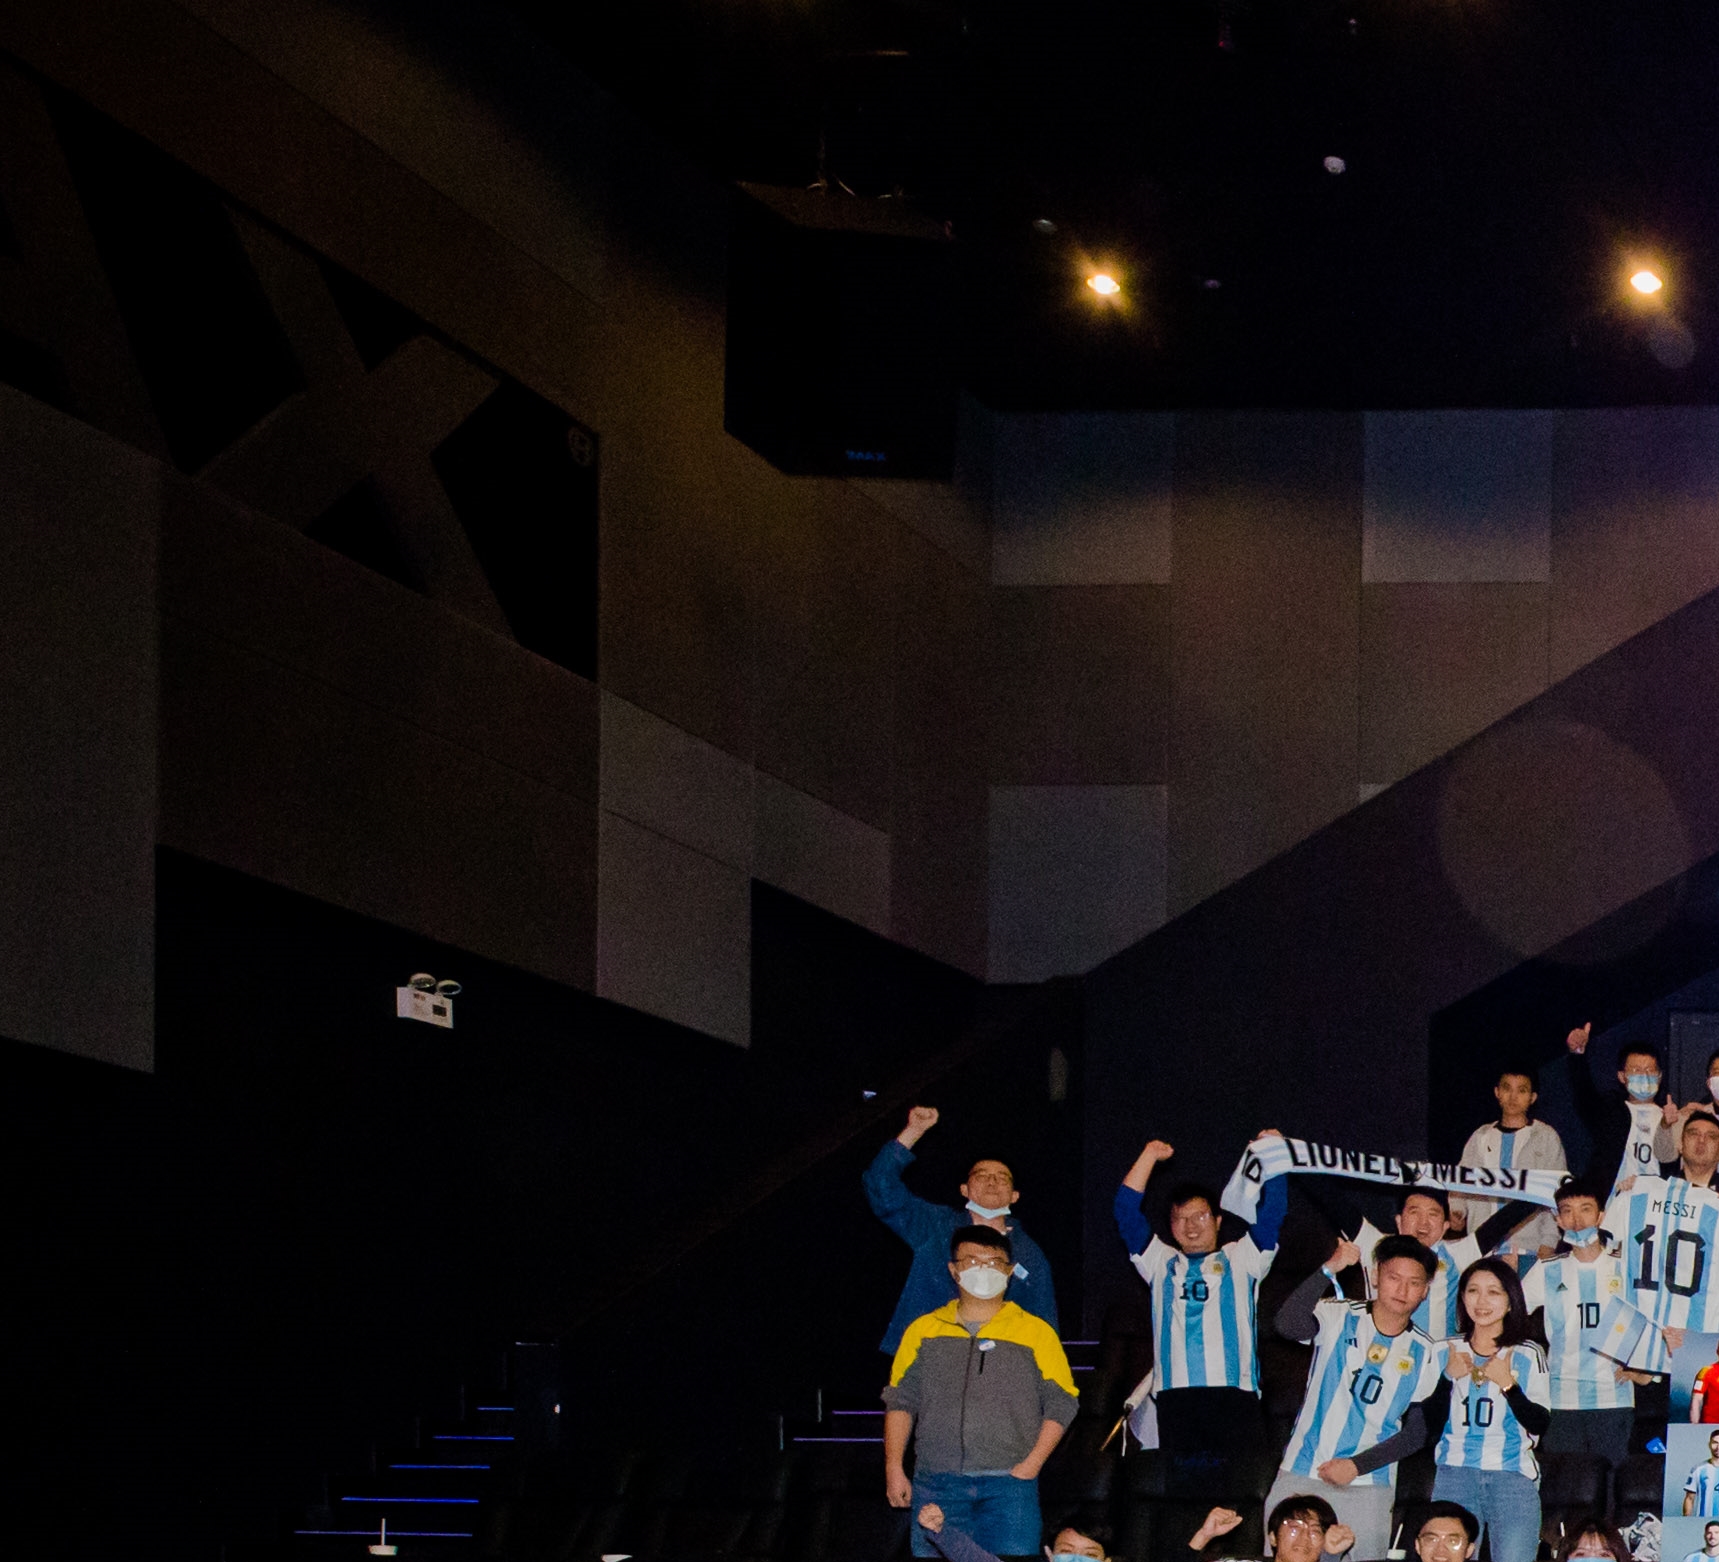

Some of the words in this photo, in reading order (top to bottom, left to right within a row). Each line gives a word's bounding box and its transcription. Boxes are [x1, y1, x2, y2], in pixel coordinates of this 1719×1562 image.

[1632, 1140, 1652, 1160] 10
[1430, 1162, 1528, 1191] MESSI
[1652, 1199, 1696, 1219] MESSI
[1632, 1225, 1705, 1298] 10
[1576, 1302, 1600, 1330] 10
[1349, 1369, 1384, 1405] 10
[1460, 1397, 1494, 1429] 10
